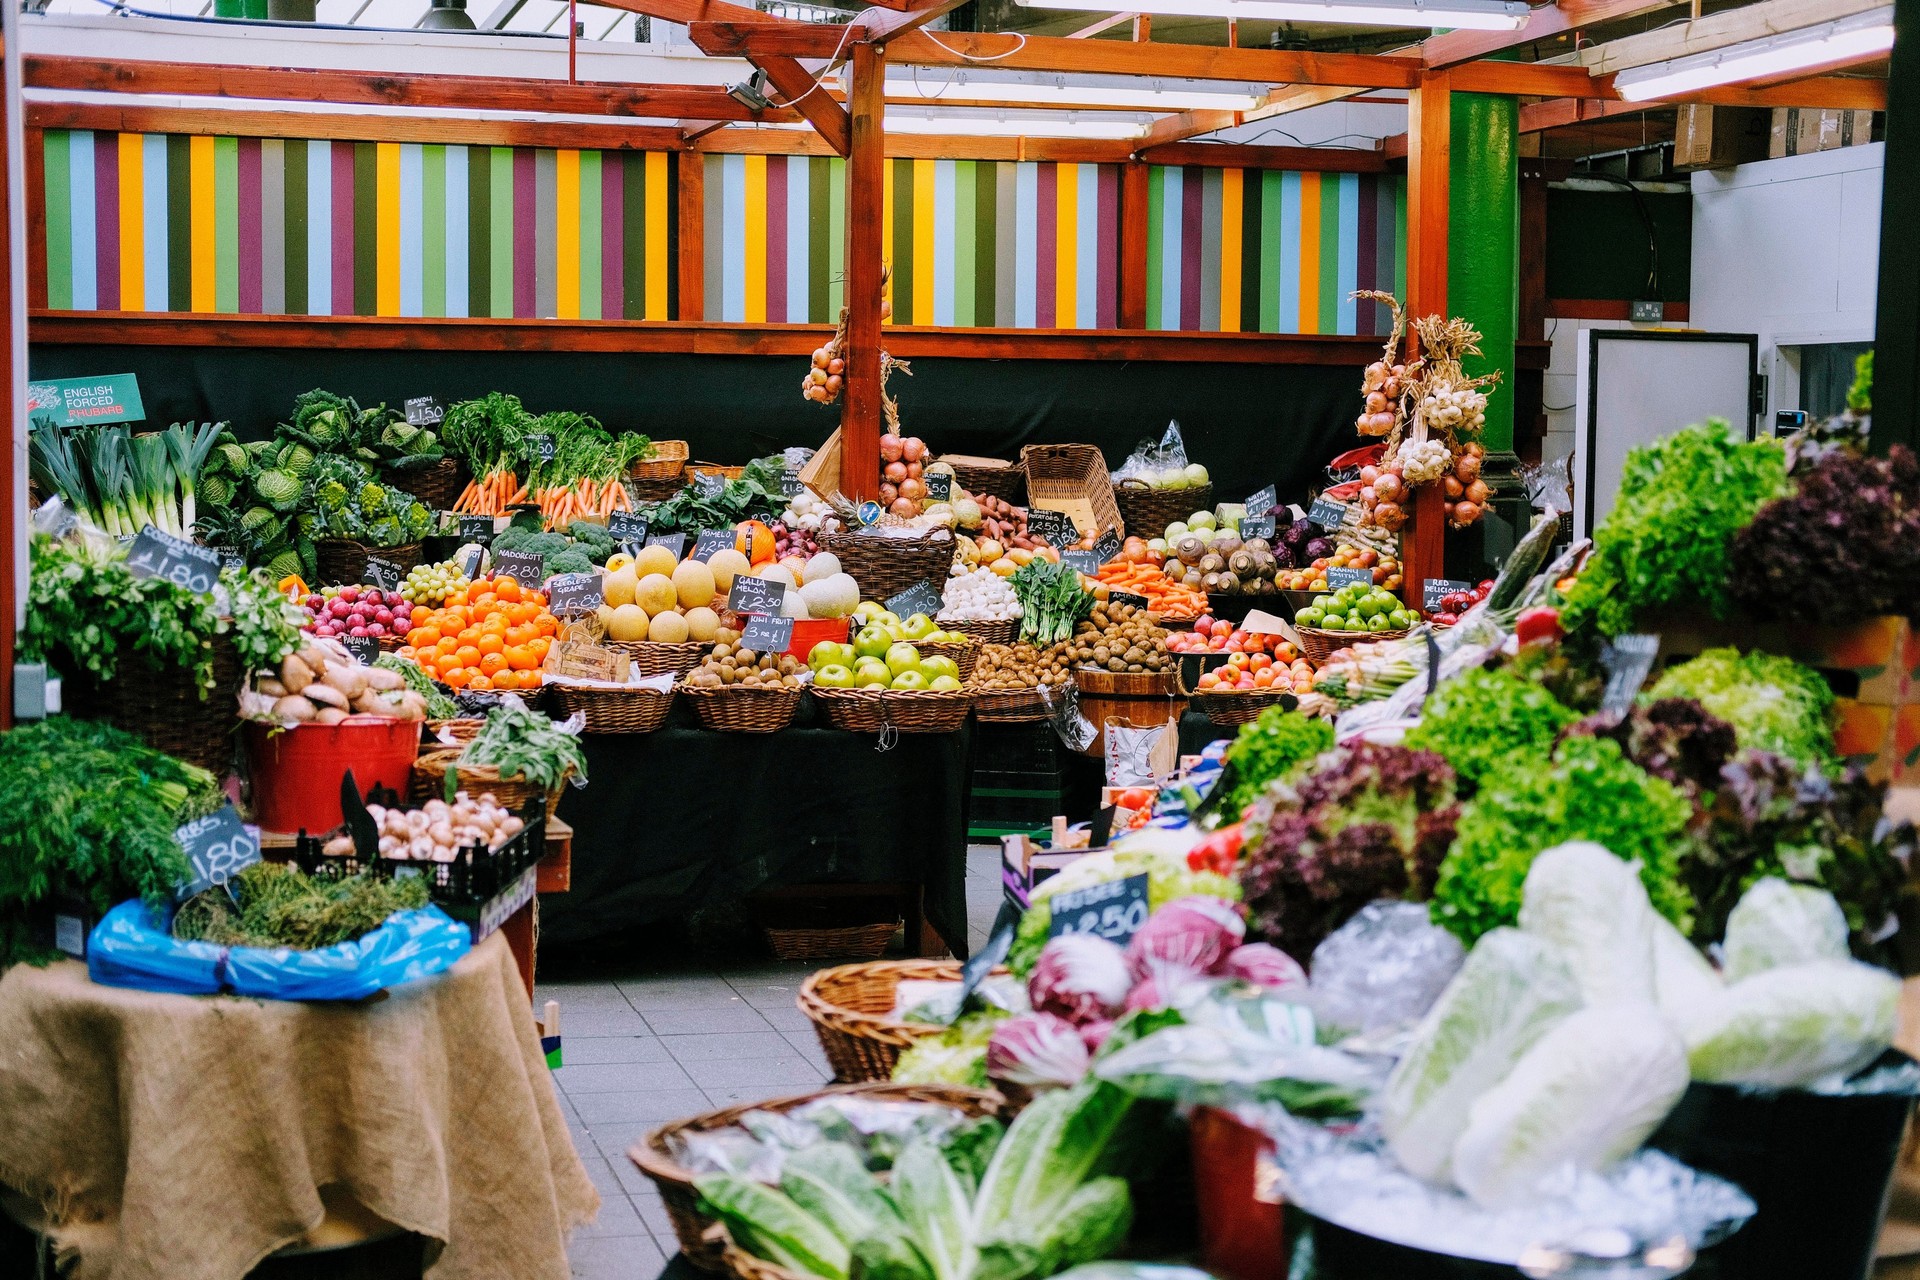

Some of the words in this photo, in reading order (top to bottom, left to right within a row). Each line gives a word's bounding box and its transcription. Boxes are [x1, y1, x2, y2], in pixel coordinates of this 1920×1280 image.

[63, 385, 113, 398] ENGLISH
[66, 396, 113, 408] FORCED
[608, 522, 646, 536] £3.30
[738, 576, 767, 588] GALIA
[1432, 579, 1450, 587] RED
[737, 595, 782, 611] £2.50
[750, 615, 768, 624] KIWI
[771, 618, 792, 626] FRUIT
[746, 626, 758, 638] 3
[770, 629, 786, 643] £1
